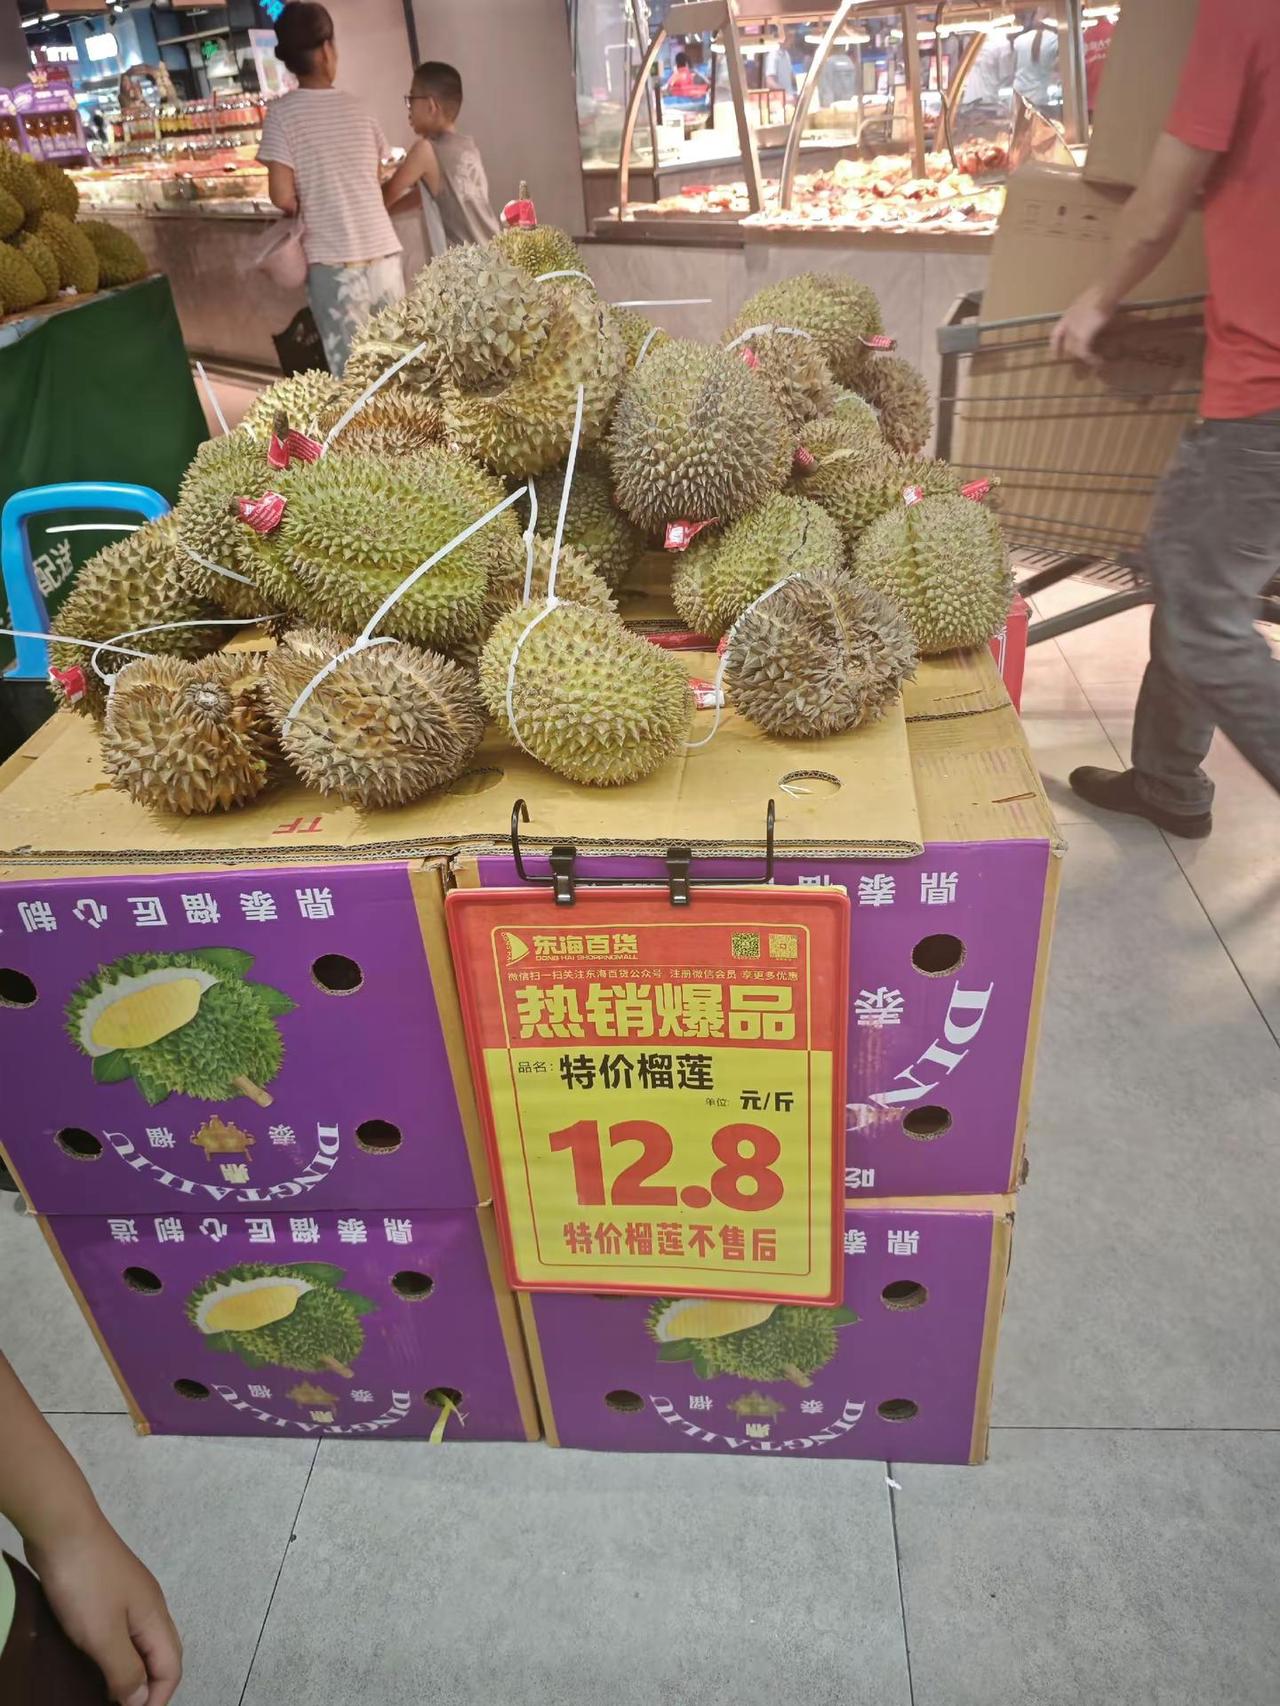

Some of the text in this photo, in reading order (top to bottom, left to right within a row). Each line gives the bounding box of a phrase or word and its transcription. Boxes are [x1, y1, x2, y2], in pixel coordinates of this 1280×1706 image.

[0, 887, 335, 933] 鼎泰榴匠心制
[532, 933, 639, 955] 东海百货
[507, 968, 799, 982] 微信扫一扫关注东海百货公众号 注册微信会员 享更多优惠
[515, 982, 797, 1041] 热销爆品
[559, 1053, 714, 1090] 特价榴莲
[739, 1090, 795, 1113] 元/斤
[102, 1121, 343, 1203] DINGTAILIU
[549, 1119, 785, 1213] 12.8
[107, 1217, 414, 1245] 鼎泰榴匠心制造
[563, 1221, 777, 1262] 特价榴莲不售后
[210, 1383, 413, 1436] DINGTAILIU
[648, 1394, 867, 1453] DINGTAILIU
